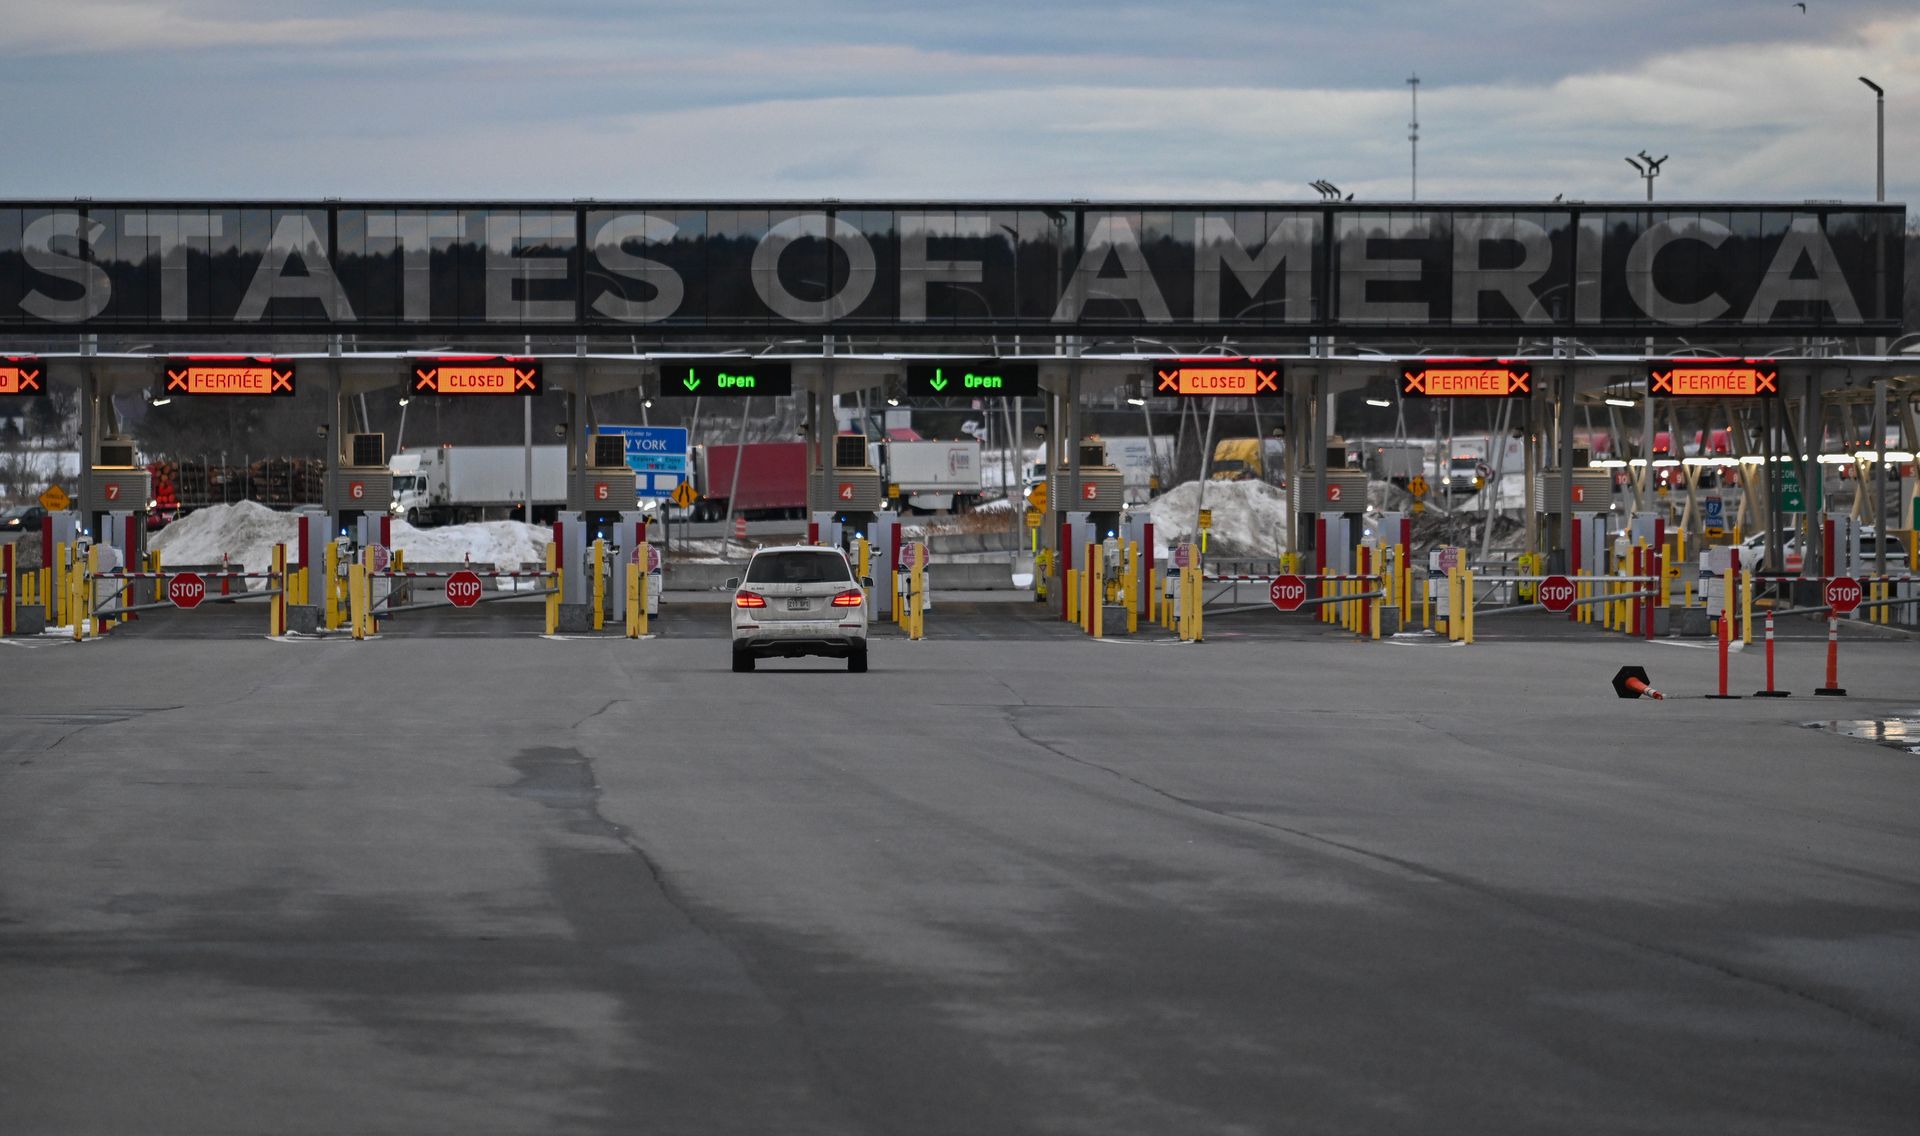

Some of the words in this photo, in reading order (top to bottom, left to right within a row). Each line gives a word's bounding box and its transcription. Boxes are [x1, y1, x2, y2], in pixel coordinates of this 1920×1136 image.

[18, 213, 685, 322] STATES
[751, 213, 991, 323] OF
[1050, 216, 1864, 326] AMERICA
[194, 371, 263, 388] FERMÉE
[449, 375, 504, 387] CLOSED
[717, 374, 755, 388] Open
[964, 374, 1002, 388] Open
[1191, 376, 1246, 388] CLOSED
[1431, 372, 1500, 389] FERMÉE
[1678, 372, 1747, 389] FERMÉE
[635, 439, 666, 450] YORK
[109, 487, 118, 499] 7
[353, 486, 363, 498] 6
[598, 486, 608, 499] 5
[842, 487, 853, 499] 4
[1087, 486, 1097, 499] 3
[1331, 488, 1341, 501] 2
[1577, 489, 1584, 501] 1
[1708, 503, 1719, 513] 87
[171, 581, 203, 597] STOP
[448, 581, 480, 597] STOP
[1272, 584, 1304, 600] STOP
[1541, 585, 1573, 601] STOP
[1828, 586, 1860, 602] STOP
